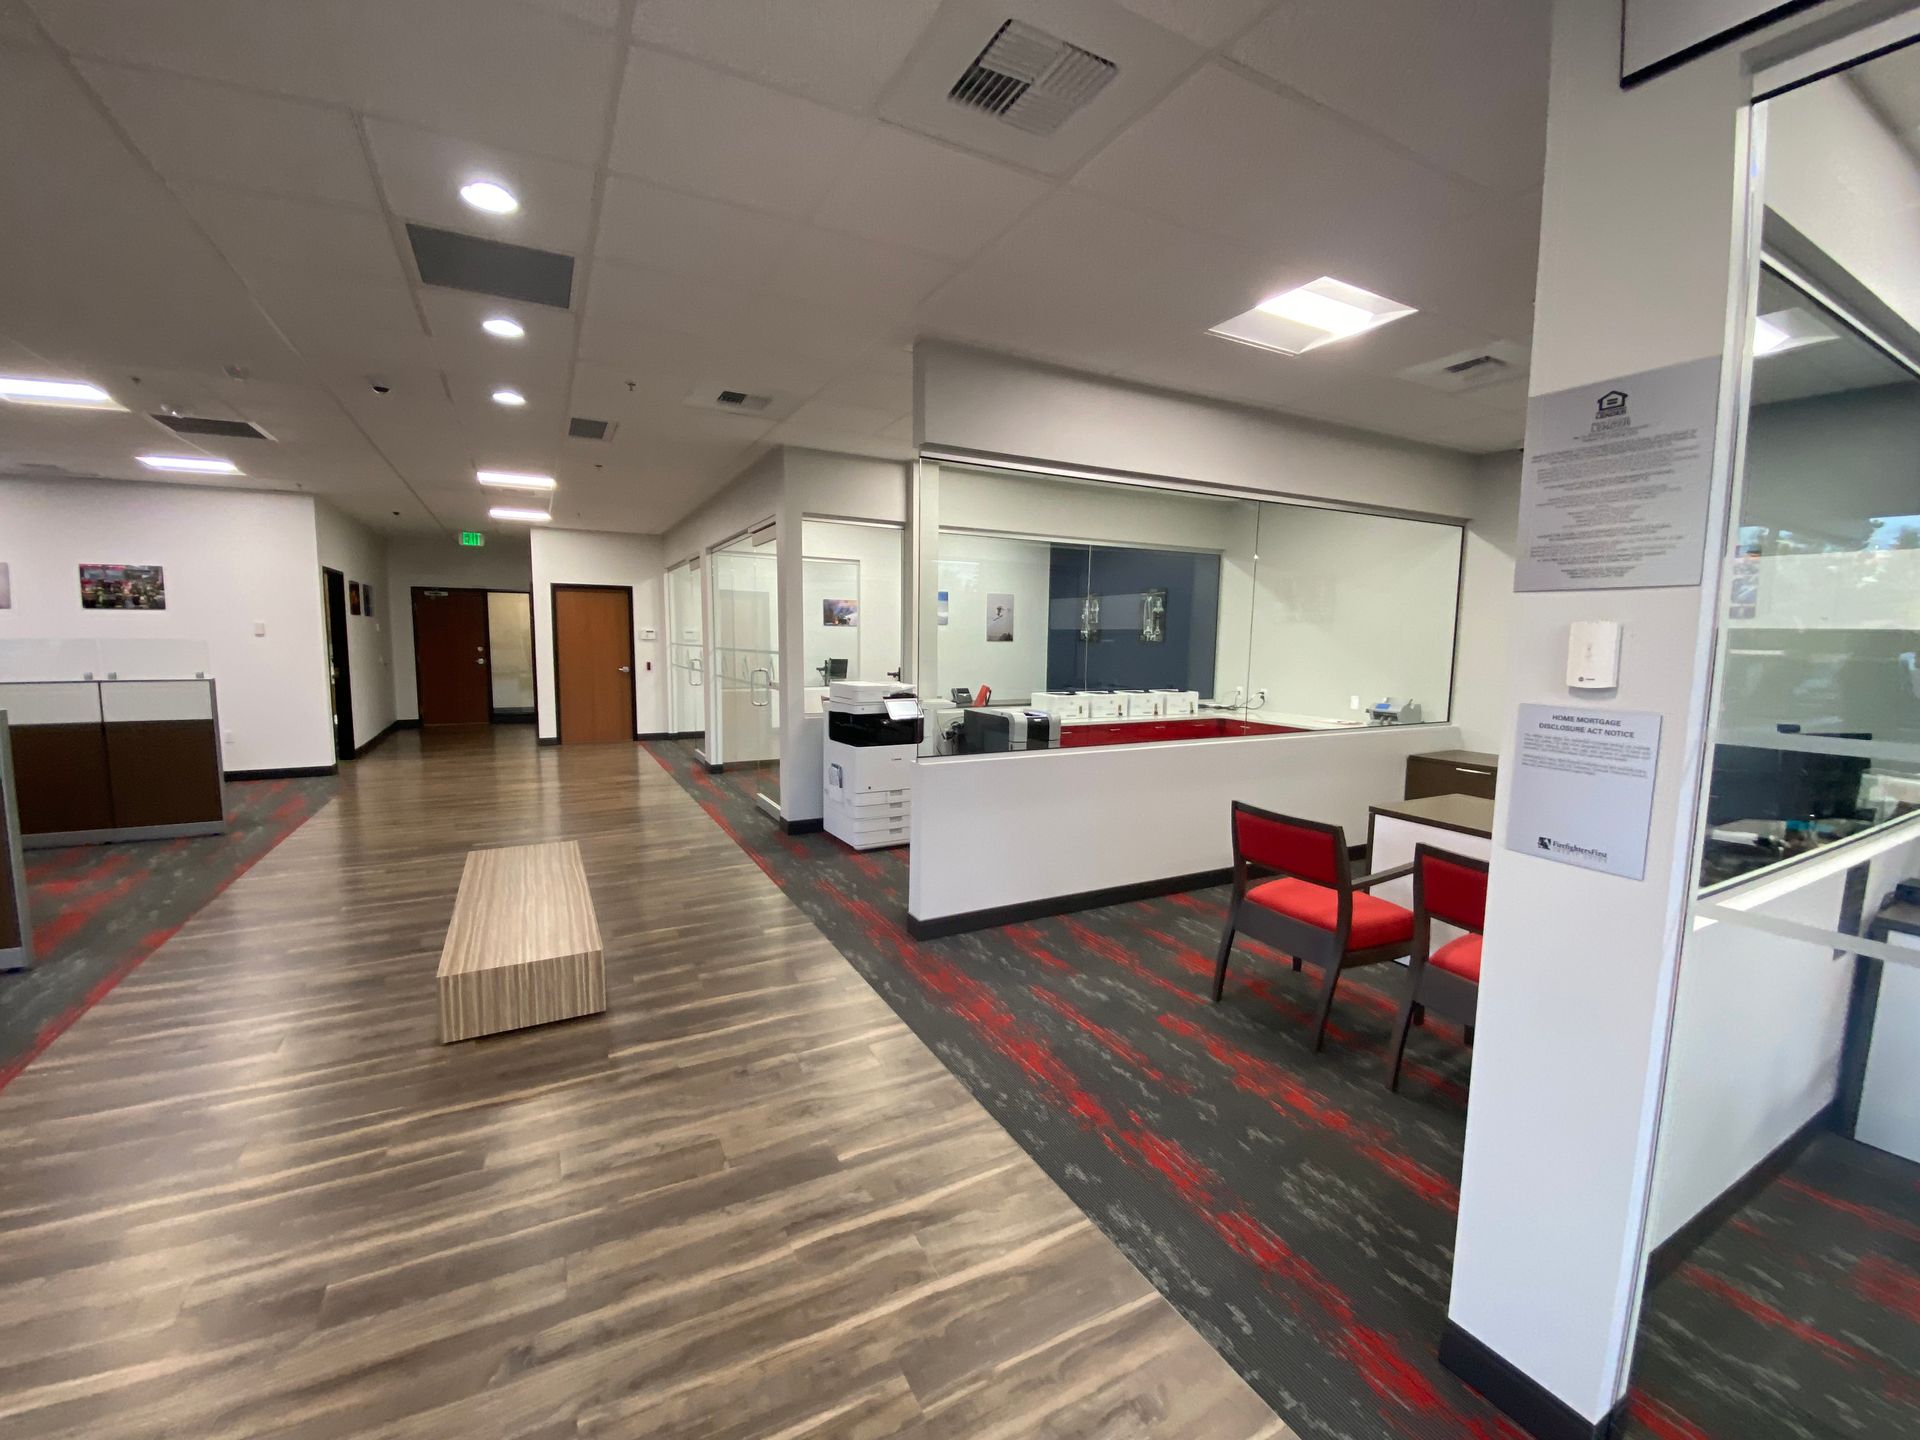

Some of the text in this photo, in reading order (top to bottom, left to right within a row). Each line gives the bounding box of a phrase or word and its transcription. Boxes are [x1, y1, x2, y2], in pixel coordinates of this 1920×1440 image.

[1552, 714, 1622, 727] HOME MORTGAGE
[1538, 722, 1635, 738] DISCLOSURE ACT NOTICE
